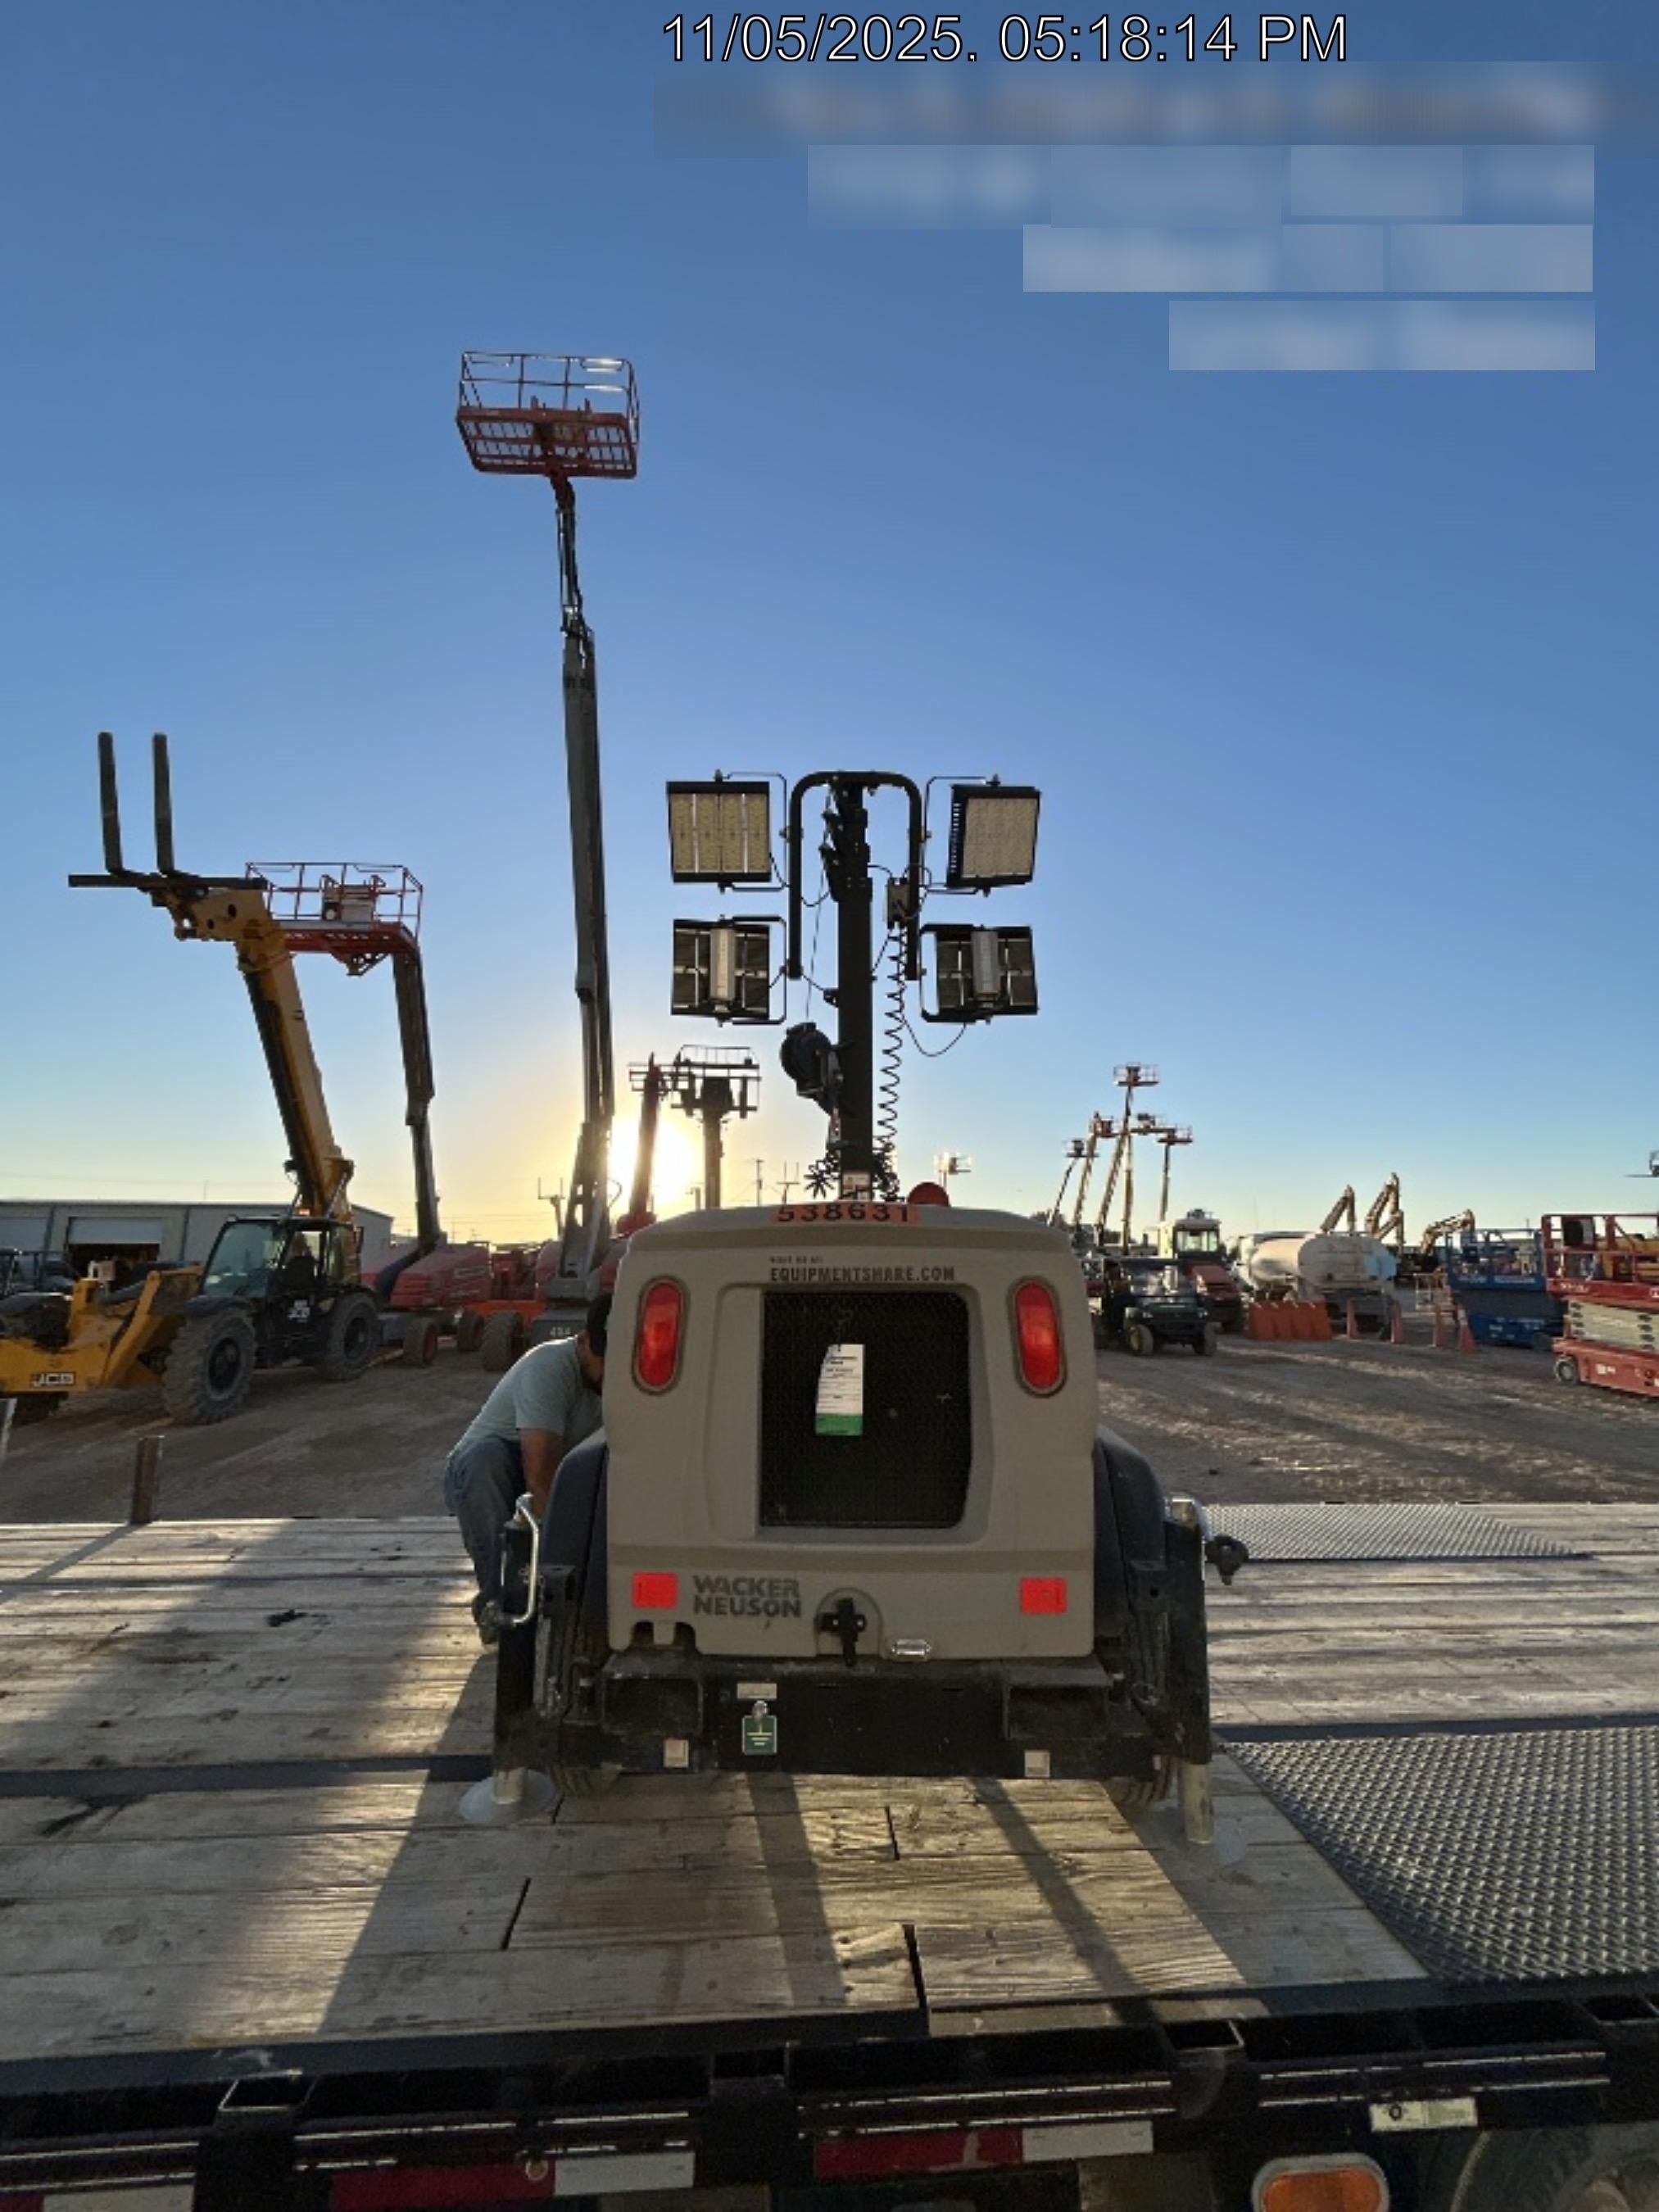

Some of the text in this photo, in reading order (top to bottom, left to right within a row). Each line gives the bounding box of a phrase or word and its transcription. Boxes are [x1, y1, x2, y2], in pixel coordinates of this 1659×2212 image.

[777, 1203, 909, 1222] 538631
[770, 1267, 955, 1281] EQUIPMENTSHARE.COM
[693, 1575, 800, 1598] WACKER
[693, 1594, 802, 1617] NEUSON
